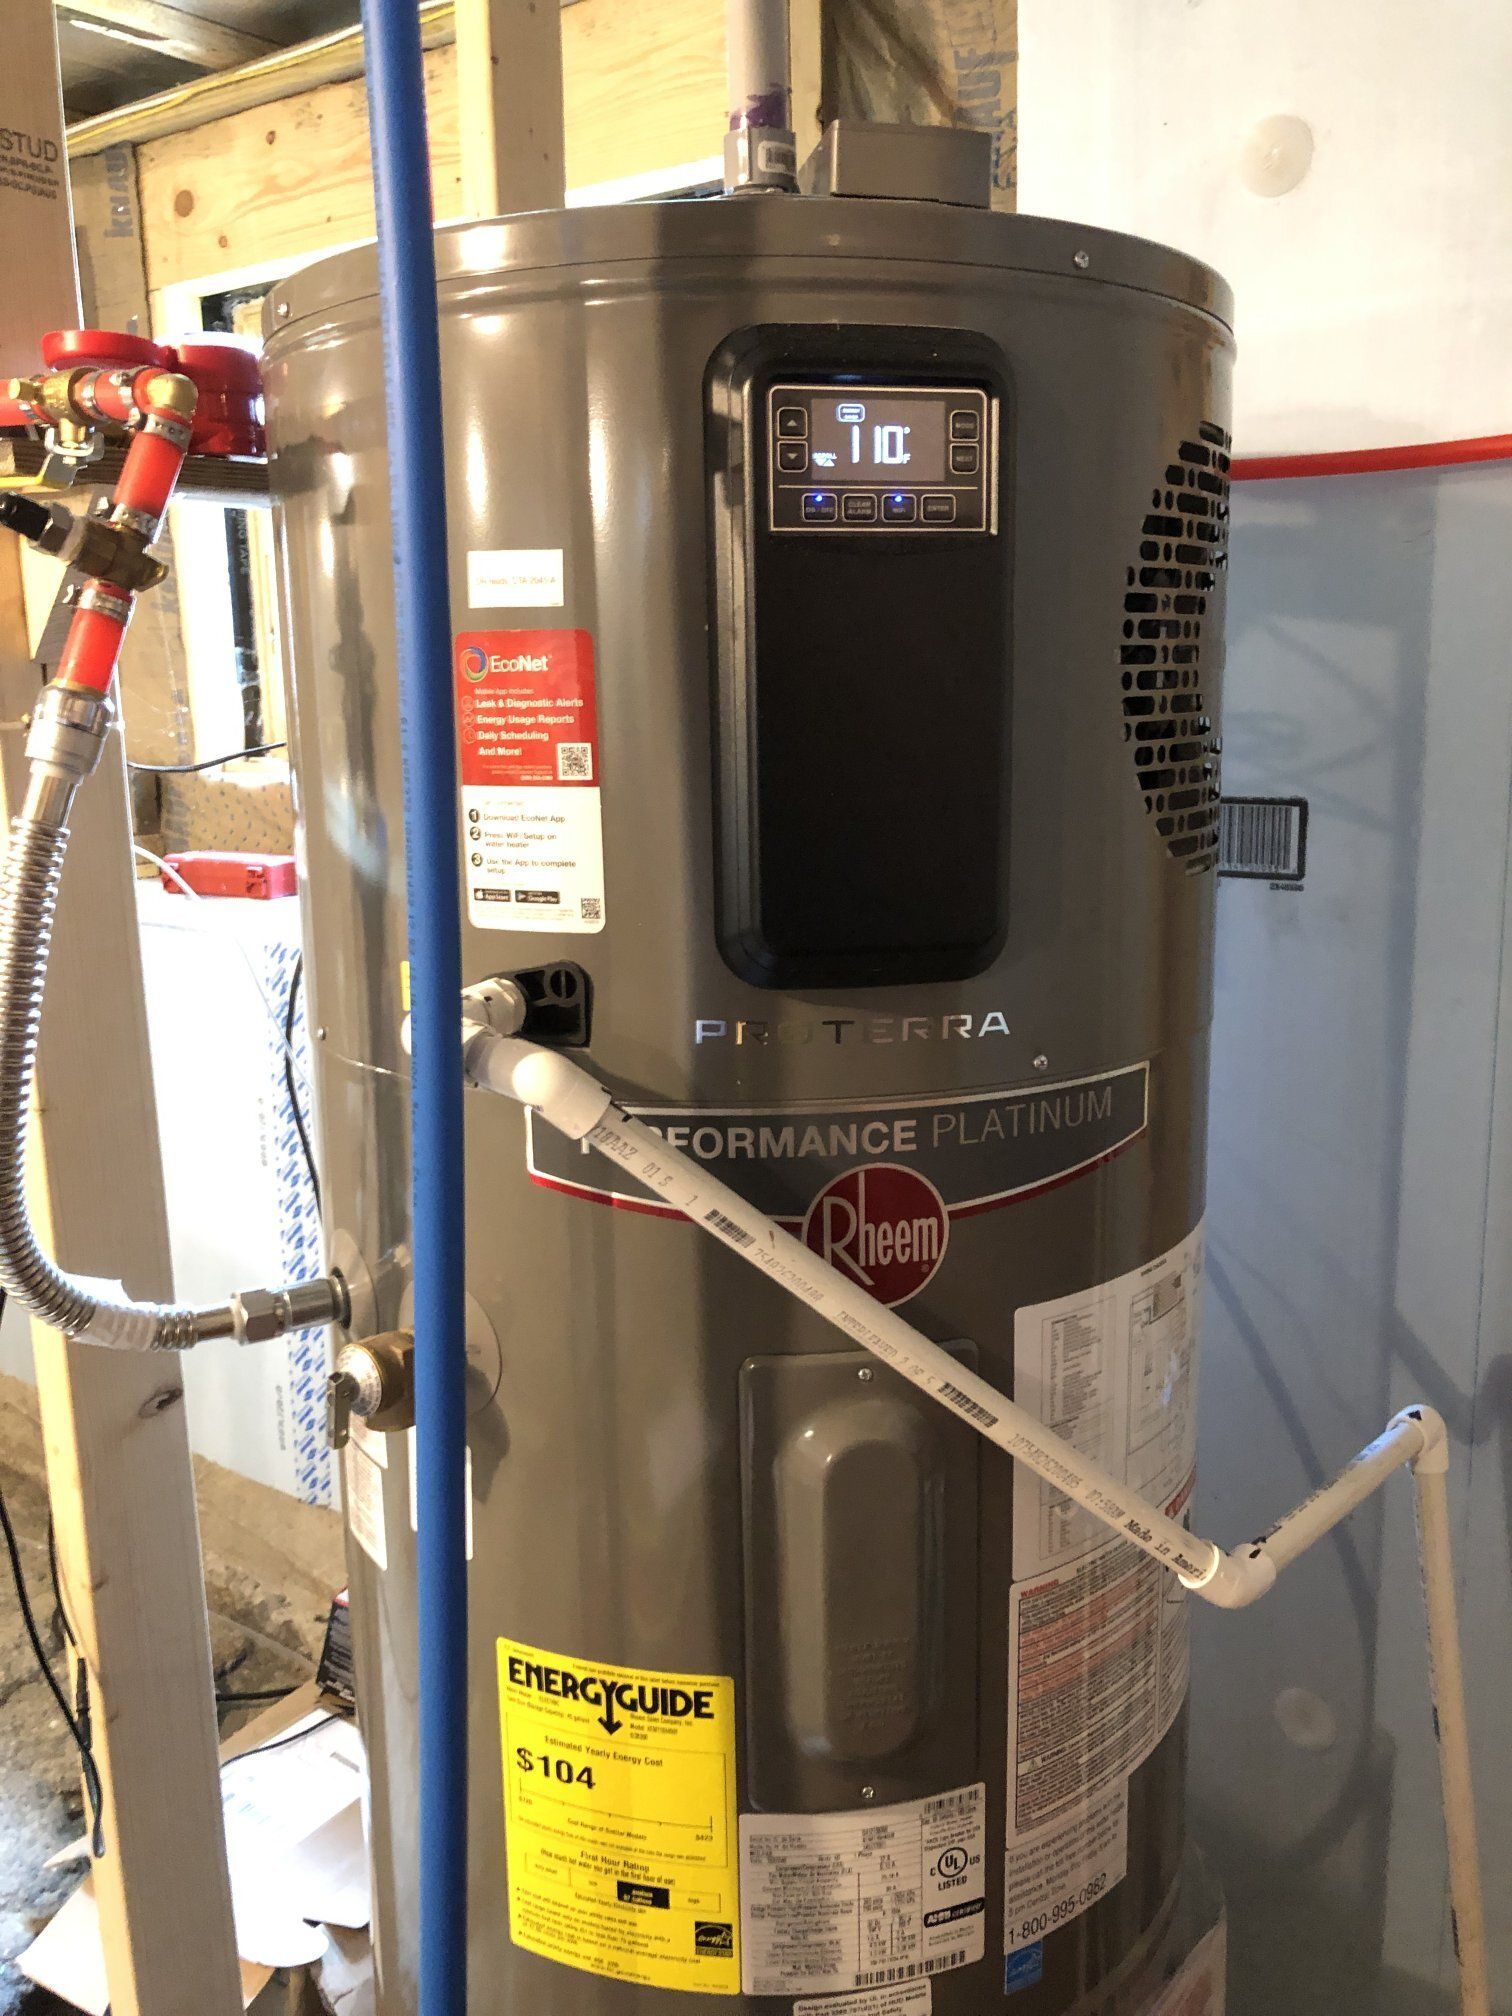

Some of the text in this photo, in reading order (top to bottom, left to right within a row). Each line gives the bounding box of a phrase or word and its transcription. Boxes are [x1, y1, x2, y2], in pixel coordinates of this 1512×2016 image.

[0, 127, 58, 162] STUD
[490, 655, 549, 673] EcoNet
[477, 699, 497, 709] Leak
[507, 698, 554, 710] Diagnostic
[556, 698, 583, 707] Alerts
[477, 714, 574, 726] Energy Usage Reports
[478, 730, 549, 742] Daily Scheduling
[479, 747, 496, 756] And
[521, 814, 548, 822] EcoNet
[550, 815, 566, 823] App
[507, 841, 529, 849] heater
[524, 833, 546, 841] Setup
[515, 859, 530, 868] App
[541, 860, 577, 868] complete
[695, 1011, 1010, 1045] PROTERRA
[933, 1086, 1112, 1148] PLATINUM
[822, 1170, 939, 1286] Rheem
[1124, 1518, 1153, 1543] Made
[1154, 1540, 1171, 1556] in
[1171, 1552, 1208, 1580] Ameri
[1020, 1578, 1059, 1598] WARNING
[545, 1735, 664, 1767] Estimated Yearly Energy Cost
[516, 1747, 596, 1790] $104
[626, 1831, 648, 1841] Models
[580, 1850, 650, 1873] First Hour Rating
[945, 1853, 960, 1871] UL
[969, 1853, 980, 1866] US
[1016, 1853, 1027, 1862] you
[1029, 1846, 1040, 1856] are
[1009, 1858, 1044, 1877] installation
[937, 1875, 968, 1891] LISTED
[1009, 1877, 1031, 1892] please
[824, 2000, 858, 2010] evaluated
